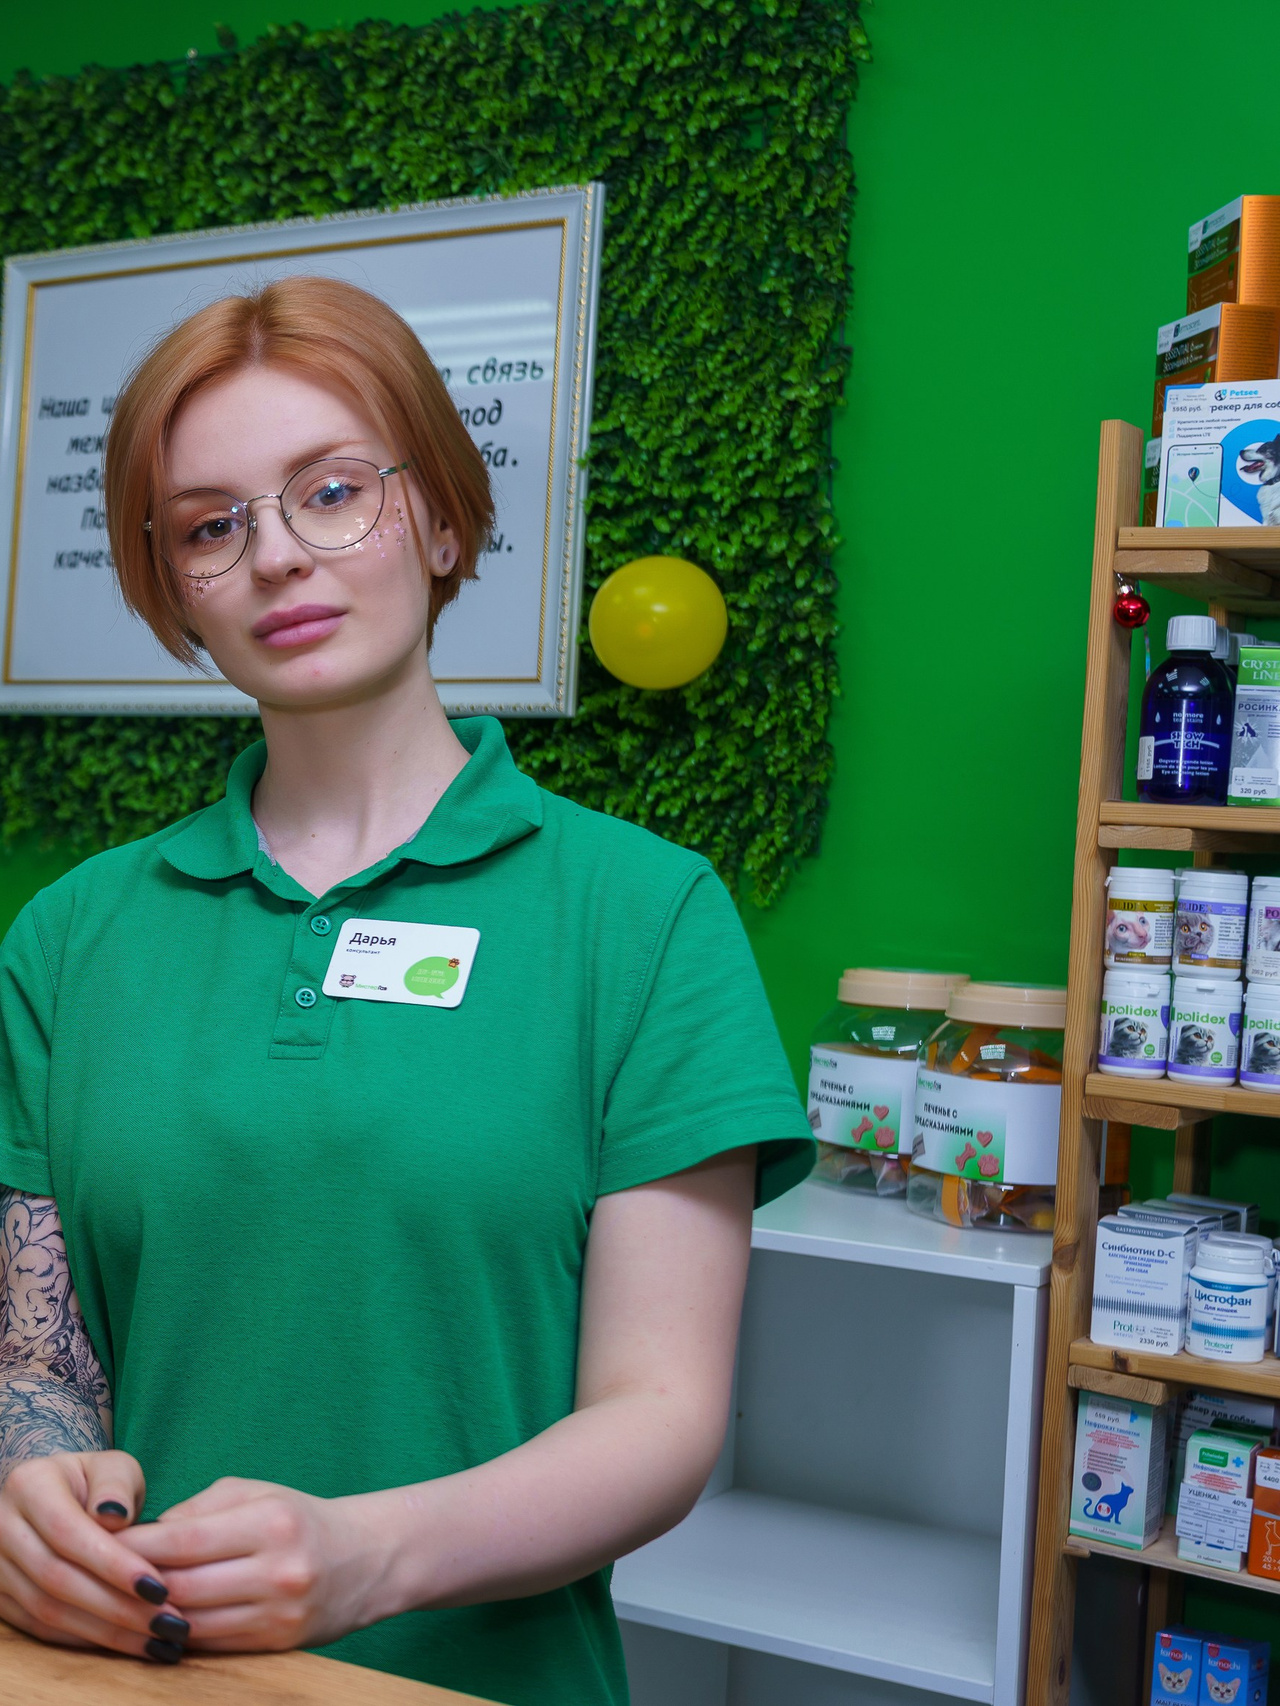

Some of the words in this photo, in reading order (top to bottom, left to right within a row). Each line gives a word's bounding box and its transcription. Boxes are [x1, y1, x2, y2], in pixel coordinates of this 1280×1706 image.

[39, 397, 90, 419] Наша
[467, 357, 544, 385] связь
[1229, 389, 1259, 397] Petsee
[1211, 404, 1241, 413] рекер
[1243, 402, 1263, 411] для
[1253, 669, 1280, 680] LINE
[1238, 703, 1280, 711] РОСИНК
[349, 932, 397, 947] Дарья
[1108, 1005, 1158, 1017] polidex
[1176, 1011, 1226, 1025] polidex
[820, 1079, 846, 1093] ПЕЧЕНЬЕ
[810, 1090, 870, 1112] ПРЕДСКАЗАНИЯМИ
[923, 1102, 951, 1117] ПЕЧЕНЬЕ
[914, 1115, 973, 1137] ПРЕДСКАЗАНИЯМИ
[1115, 1226, 1164, 1237] GASTROINTESTINAL
[1101, 1242, 1155, 1256] Синбиотик
[1157, 1249, 1176, 1259] D-C
[1194, 1288, 1252, 1307] Цистофан
[1113, 1320, 1134, 1333] Prot
[1139, 1337, 1155, 1345] 2330
[1181, 1402, 1210, 1415] рекер
[1211, 1409, 1228, 1419] для
[1188, 1488, 1220, 1501] УЦЕНКА!
[1232, 1499, 1247, 1508] 40%
